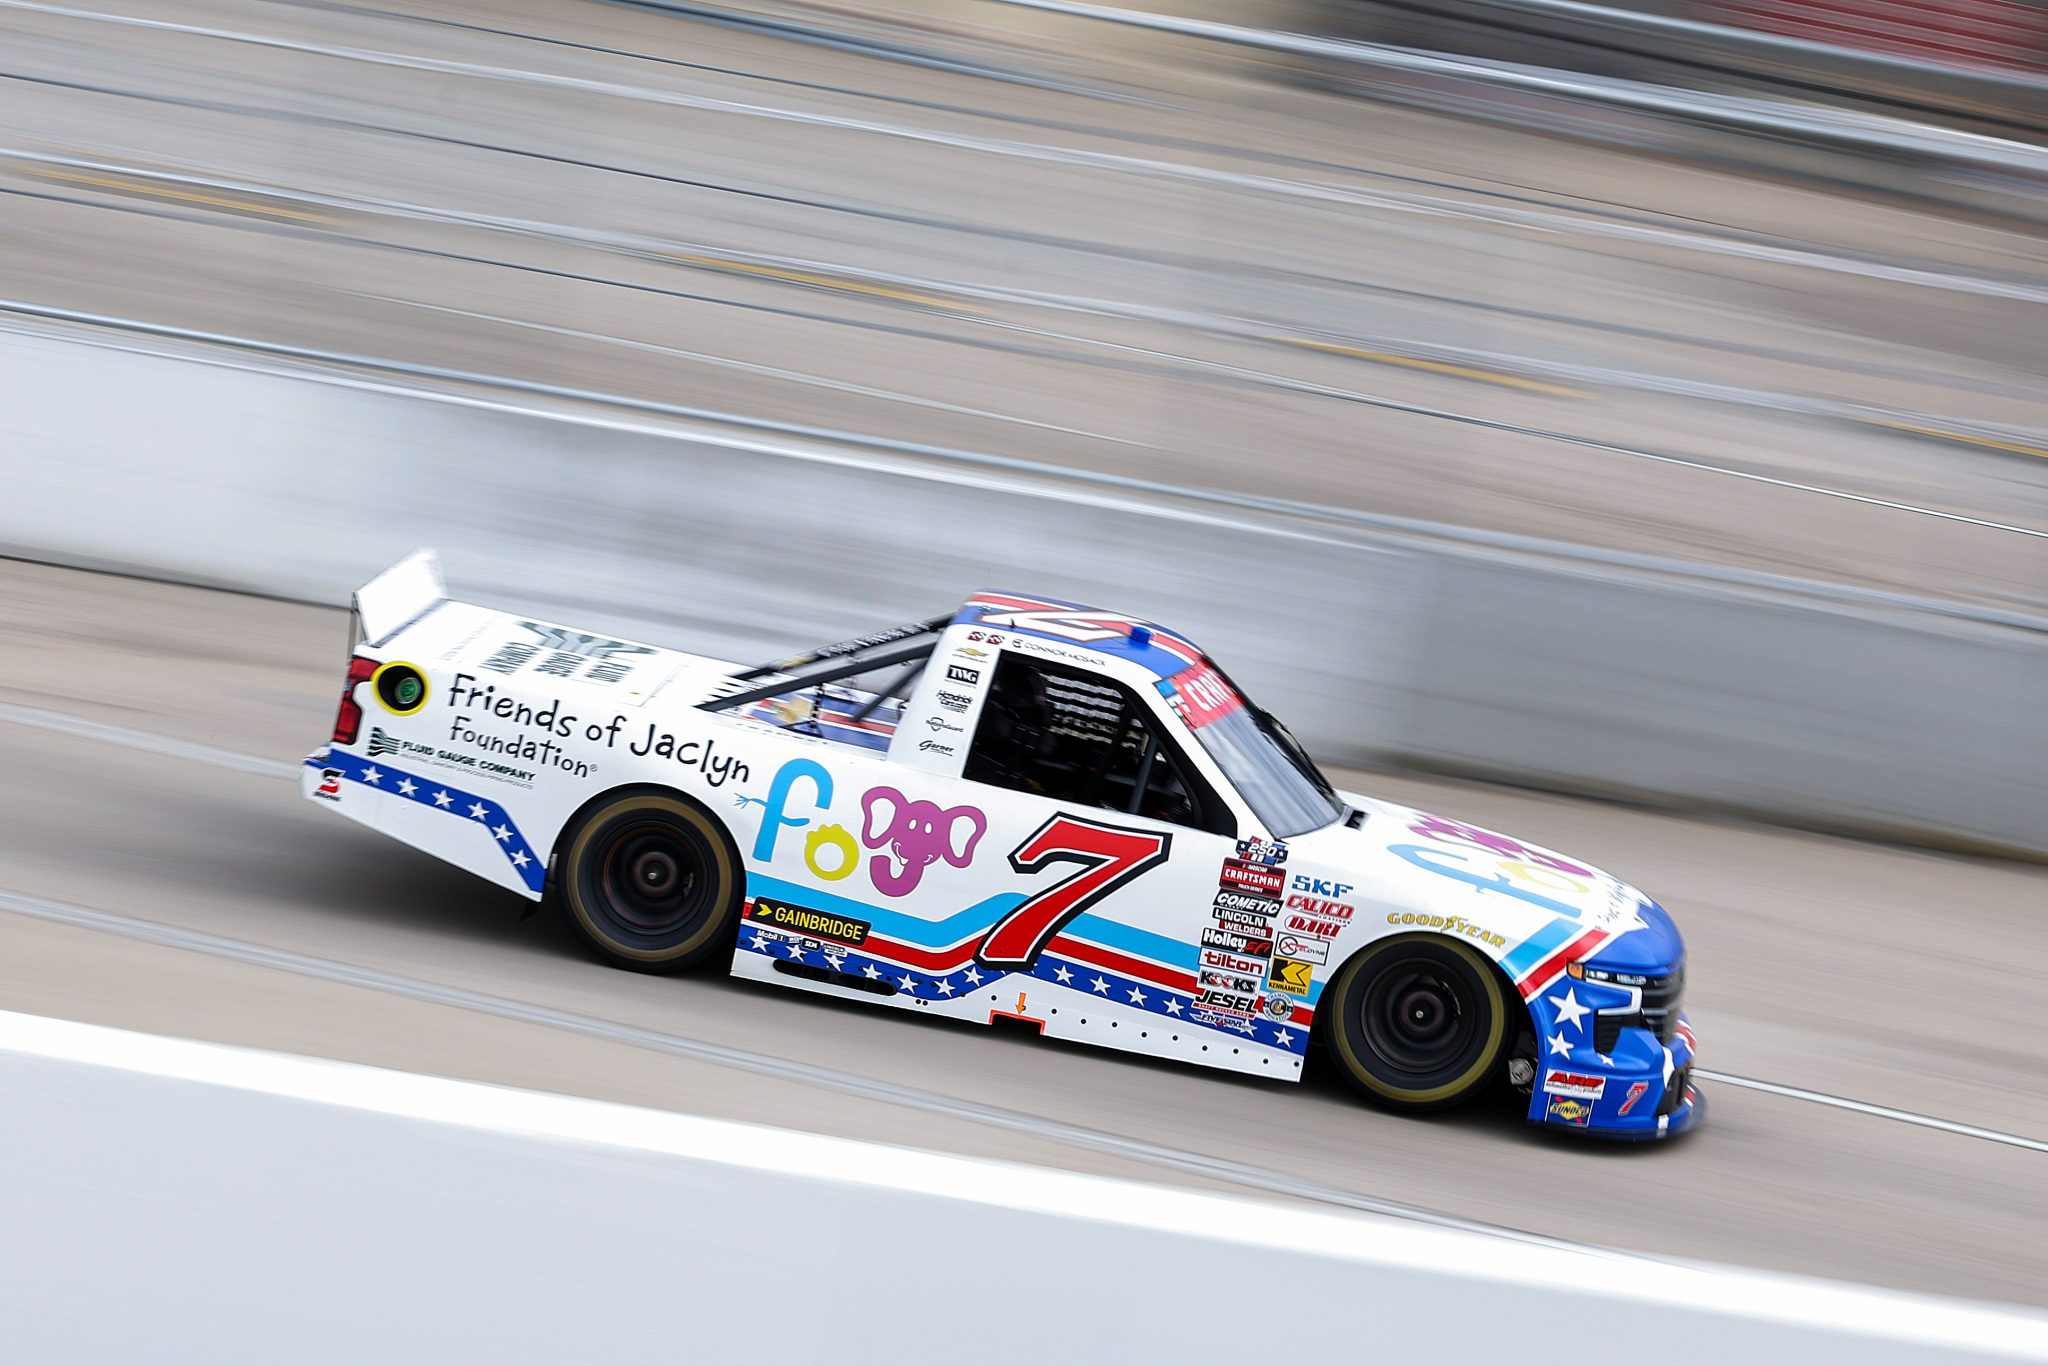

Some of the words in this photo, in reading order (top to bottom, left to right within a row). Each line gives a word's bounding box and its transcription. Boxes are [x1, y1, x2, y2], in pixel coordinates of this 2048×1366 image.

[951, 667, 977, 683] TWG
[448, 672, 579, 738] Friends
[586, 714, 627, 748] of
[629, 723, 750, 788] Jaclyn
[401, 740, 435, 756] FLUID
[478, 759, 536, 781] COMPANY
[1247, 842, 1278, 857] 250
[1224, 868, 1281, 888] CRAFTSMAN
[1292, 874, 1354, 898] SKF
[972, 811, 1173, 971] 7
[1216, 892, 1280, 914] COMETIC
[1286, 894, 1355, 920] CALICO
[775, 907, 864, 941] GAINBRIDGE
[1214, 908, 1264, 927] LINCOLN
[1224, 920, 1267, 937] WELDERS
[757, 929, 778, 940] Mobil
[1203, 928, 1247, 952] Holley
[1387, 912, 1506, 949] GOODYEAR
[1204, 951, 1263, 974] tilton
[1200, 970, 1257, 993] KOOKS
[1268, 982, 1306, 996] KENNAMETAL
[1195, 990, 1257, 1014] JESEL
[1618, 1080, 1649, 1116] 7
[1550, 1103, 1589, 1117] SUNOCO
